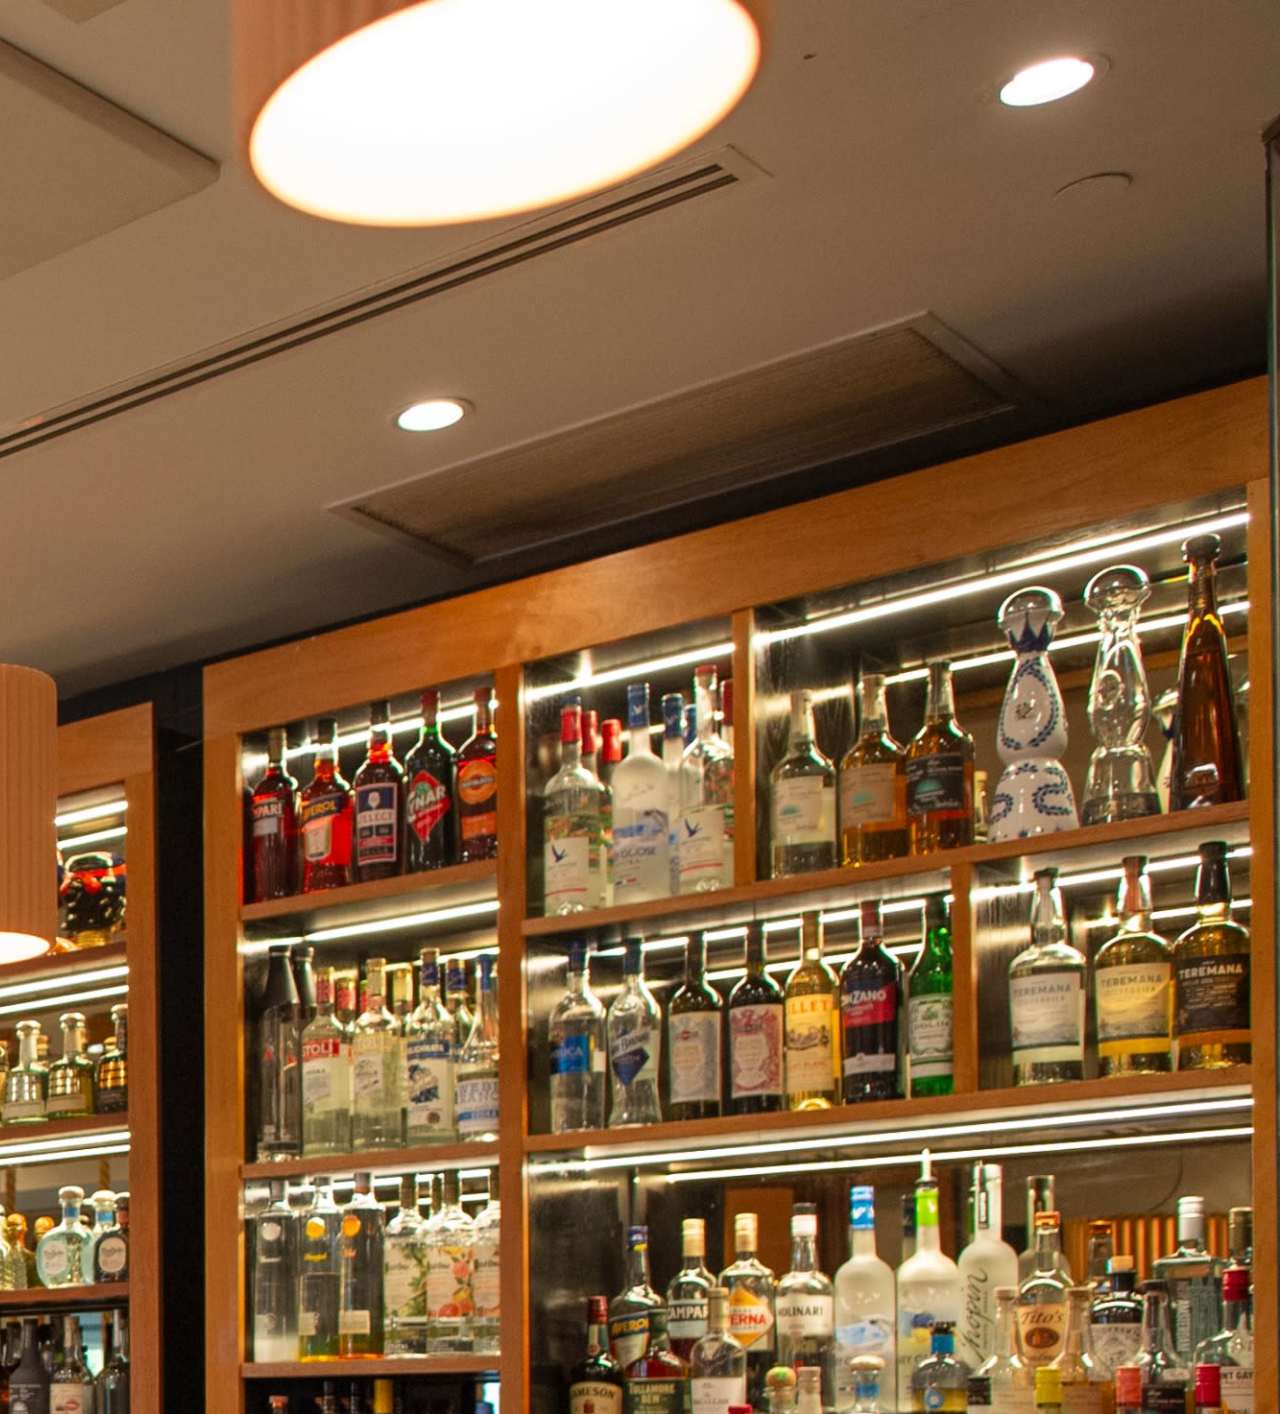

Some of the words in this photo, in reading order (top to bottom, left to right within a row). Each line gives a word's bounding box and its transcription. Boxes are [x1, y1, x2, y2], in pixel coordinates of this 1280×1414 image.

[1179, 963, 1243, 980] TEREMANA
[1101, 974, 1164, 988] TEREMANA
[842, 990, 887, 1003] NZANO
[730, 1314, 767, 1326] ERNA
[1023, 1309, 1065, 1325] Tito's
